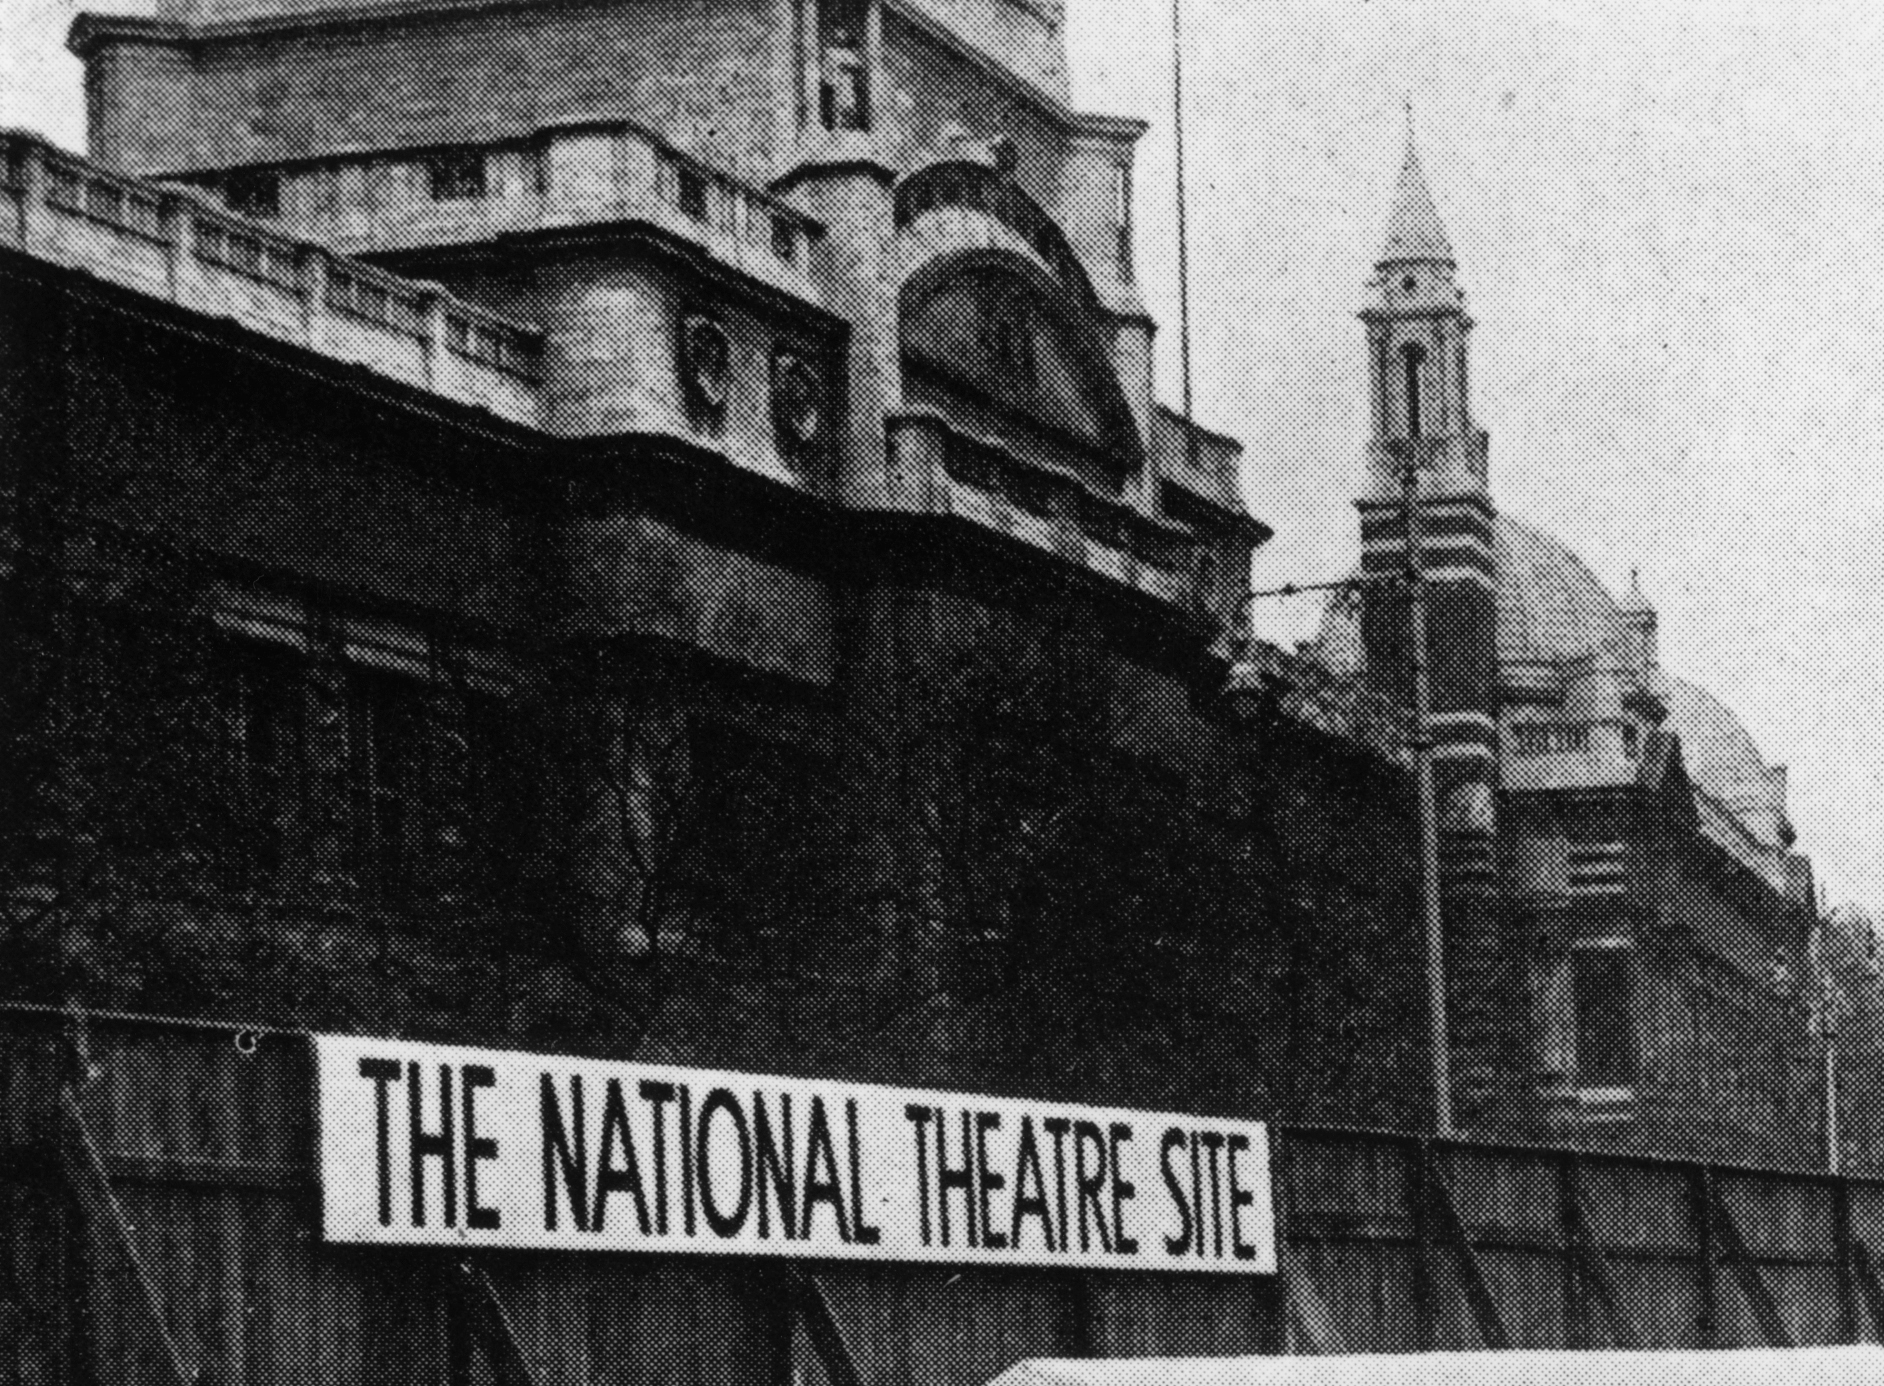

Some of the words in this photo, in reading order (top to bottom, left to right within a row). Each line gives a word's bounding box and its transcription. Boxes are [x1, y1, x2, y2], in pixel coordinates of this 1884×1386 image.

[359, 1058, 501, 1230] THE
[541, 1073, 880, 1245] NATIONAL
[905, 1105, 1138, 1254] THEATRE
[1160, 1128, 1256, 1260] SITE
